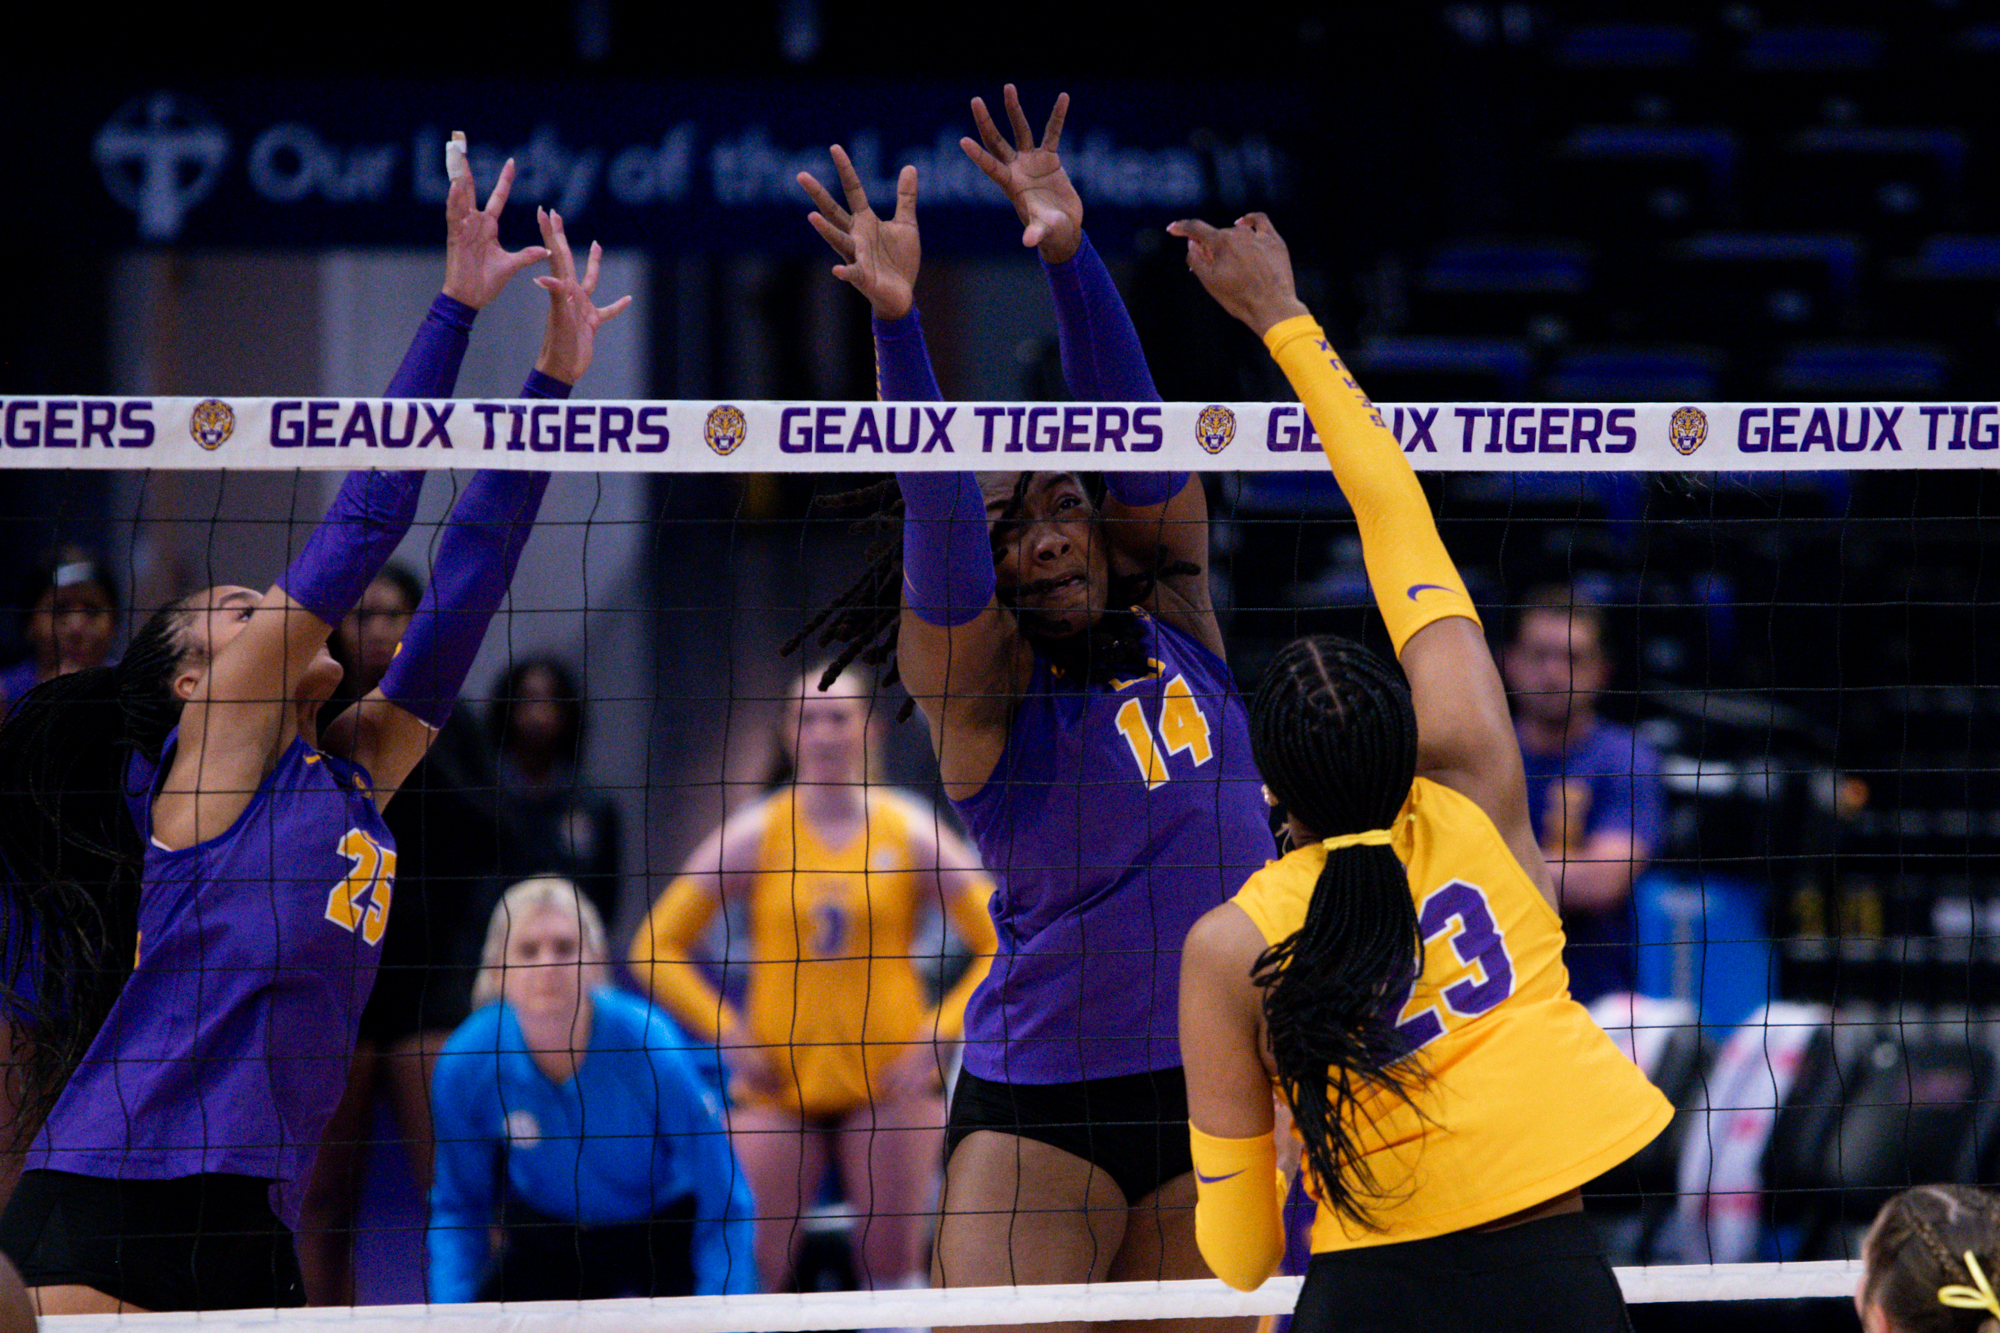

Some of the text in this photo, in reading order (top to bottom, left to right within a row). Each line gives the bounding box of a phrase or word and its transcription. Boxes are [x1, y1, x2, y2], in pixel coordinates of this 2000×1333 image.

[0, 400, 155, 448] GERS
[269, 401, 670, 453] GEAUX TIGERS
[779, 406, 1163, 453] GEAUX TIGERS
[1266, 406, 1637, 453] GEX TIGERS
[1737, 405, 2000, 453] GEAUX TIG
[1114, 673, 1213, 791] 14
[324, 827, 397, 947] 25
